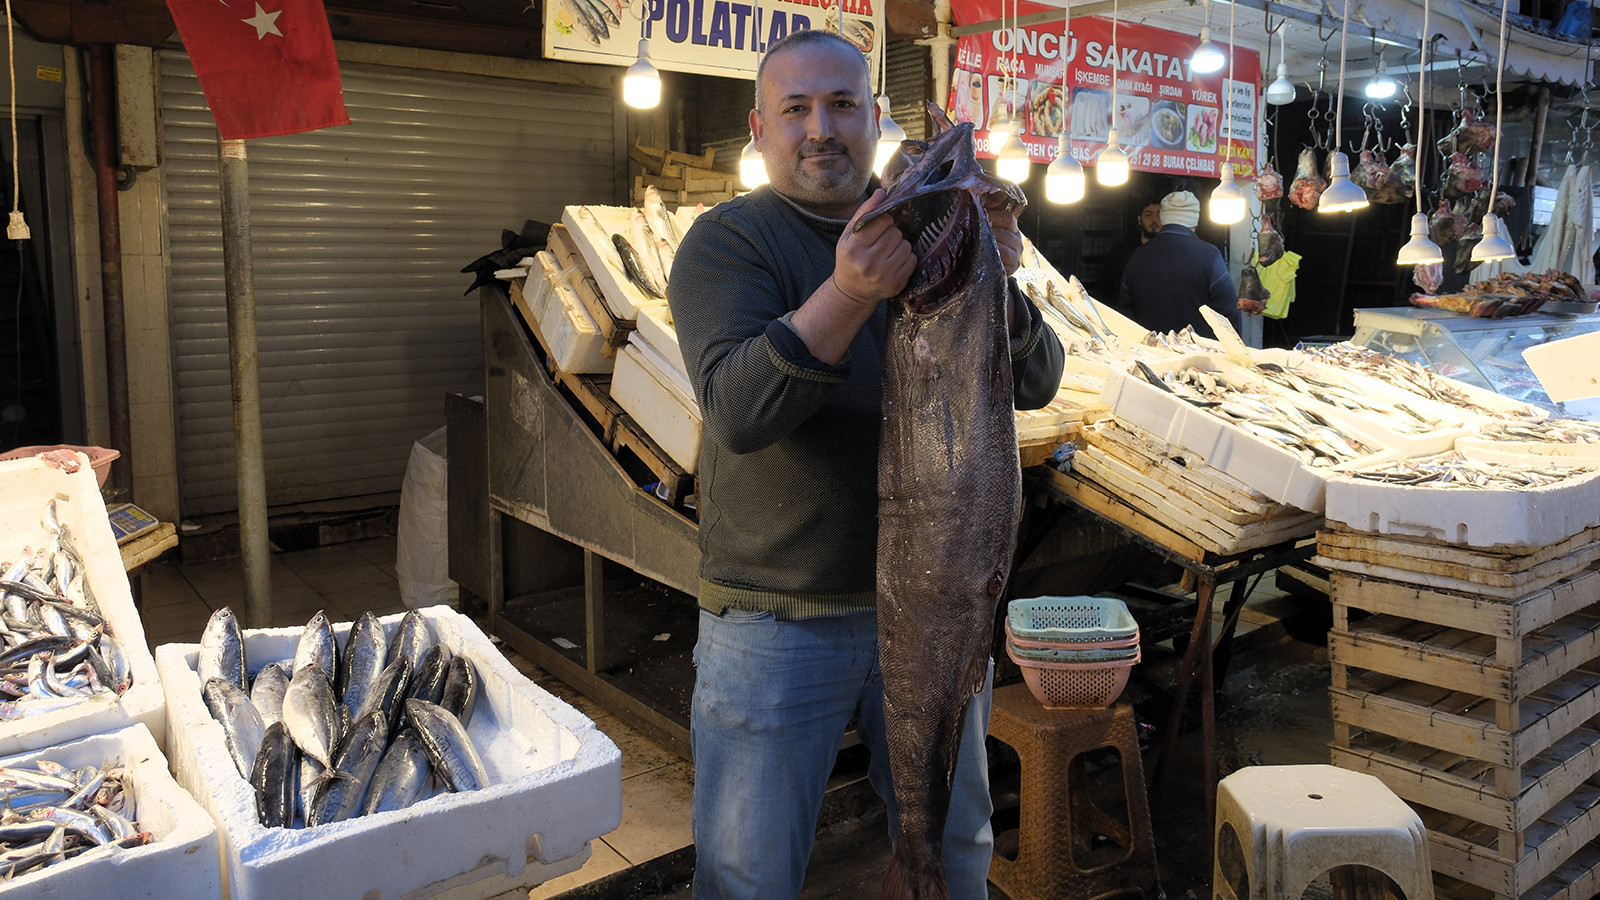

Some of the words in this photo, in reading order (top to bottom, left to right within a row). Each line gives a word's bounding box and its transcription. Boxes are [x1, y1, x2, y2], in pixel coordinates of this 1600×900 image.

[1191, 88, 1218, 104] YÜREK
[1225, 99, 1251, 111] yrlerine
[1225, 112, 1252, 124] srvisimiz
[1222, 126, 1252, 137] mvcuttur
[1162, 154, 1184, 170] BURAK
